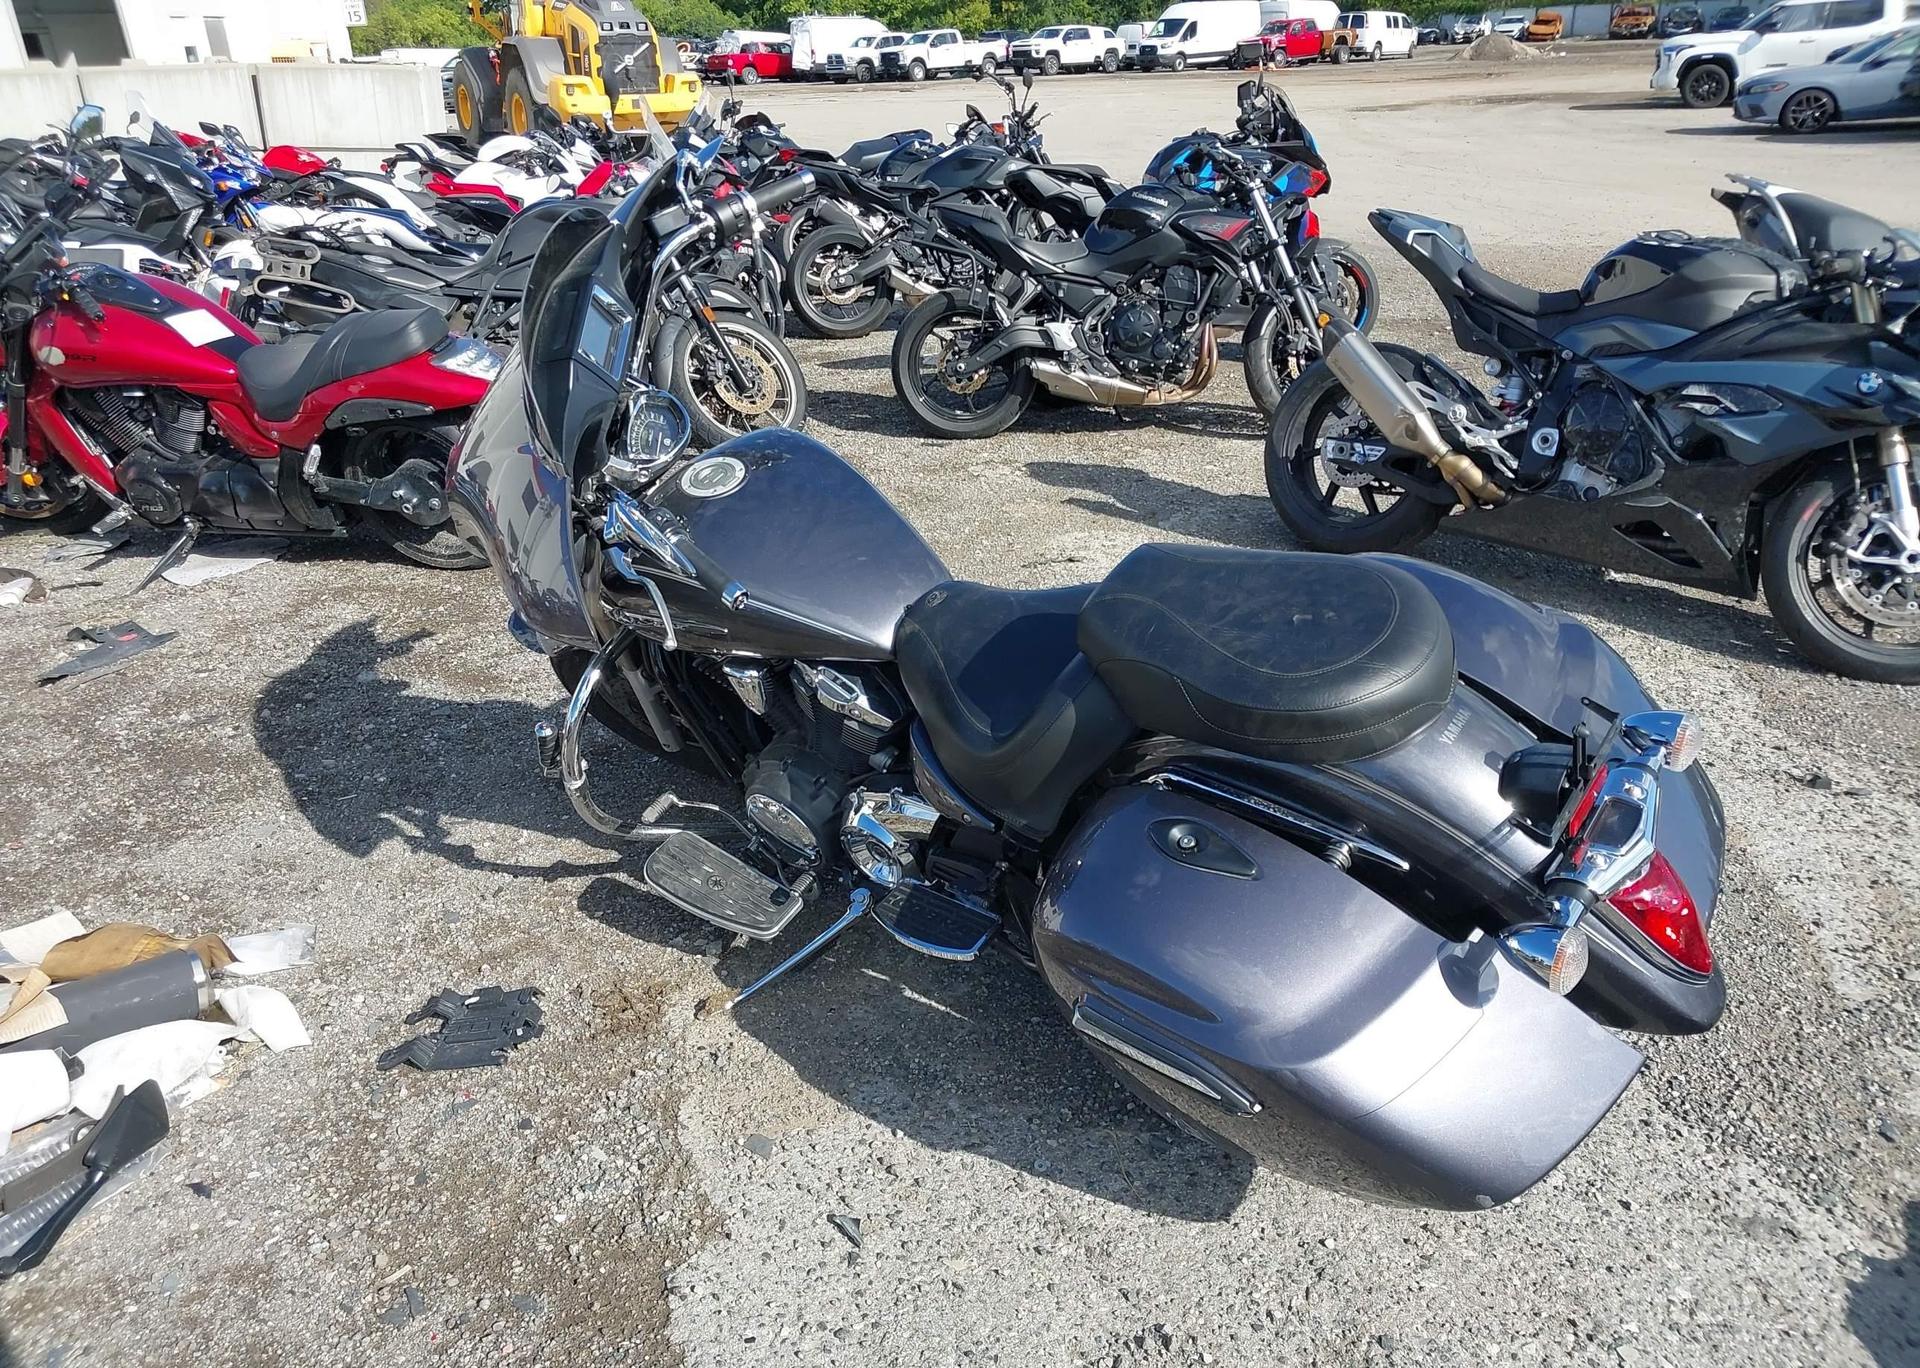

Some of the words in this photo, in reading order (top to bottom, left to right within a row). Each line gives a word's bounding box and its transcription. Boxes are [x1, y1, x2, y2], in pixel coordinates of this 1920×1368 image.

[347, 11, 362, 22] 15
[1131, 191, 1169, 207] Kawasaki
[1438, 708, 1472, 745] YAMAHA
